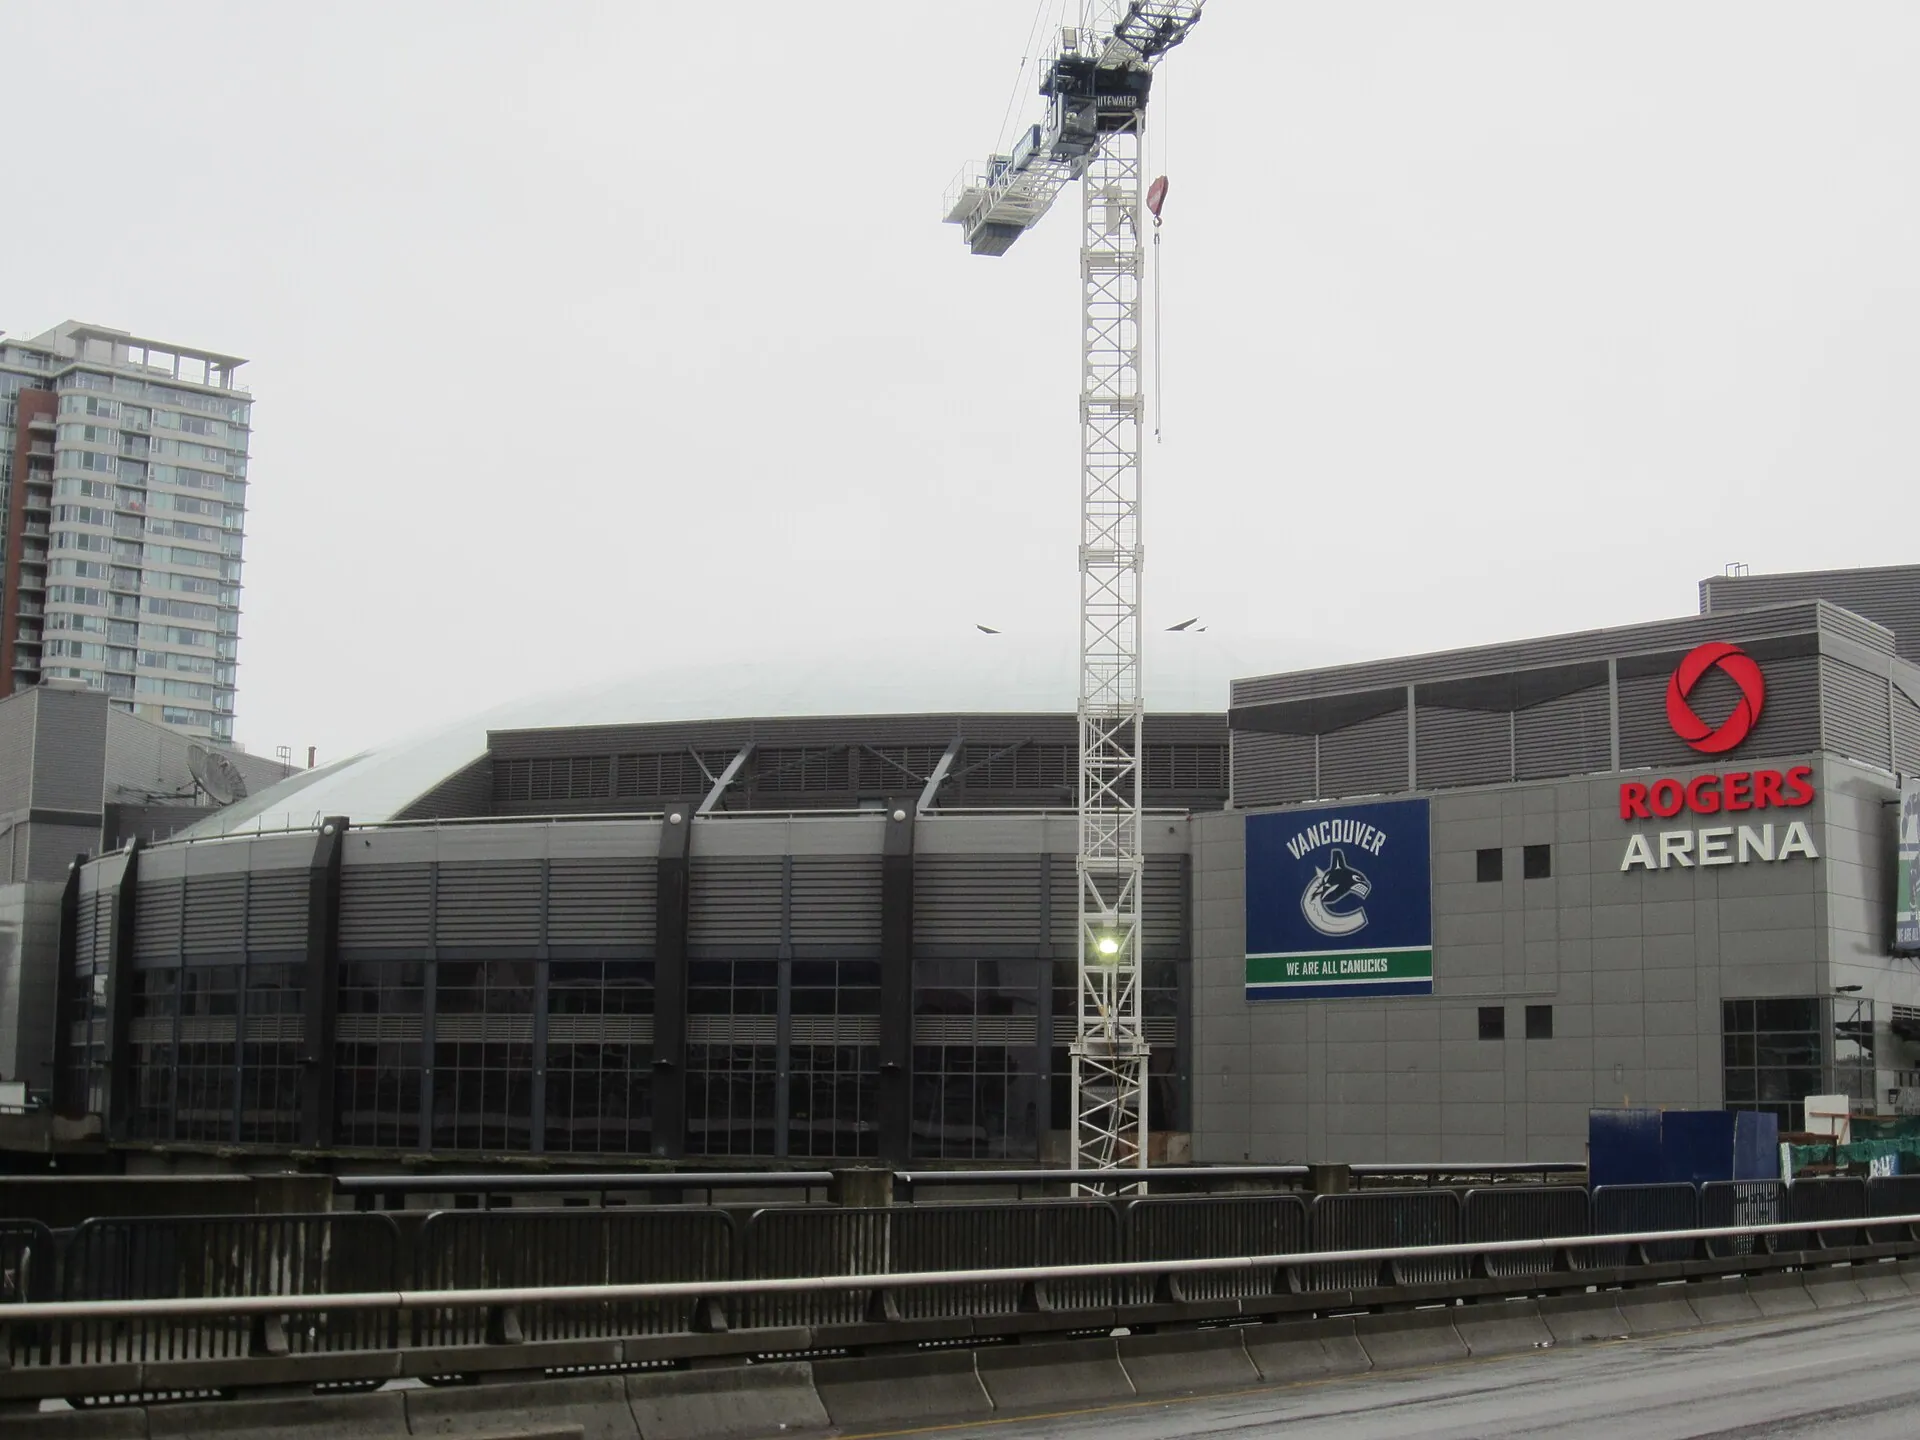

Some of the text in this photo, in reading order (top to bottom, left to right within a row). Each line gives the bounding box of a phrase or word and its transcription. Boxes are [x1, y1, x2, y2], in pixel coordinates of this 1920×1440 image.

[1097, 95, 1137, 107] ITEWATER
[1619, 766, 1814, 820] ROGERS
[1286, 819, 1387, 860] VANCOUVER
[1620, 821, 1820, 872] ARENA
[1286, 958, 1388, 976] WE ARE ALL CANUCKS
